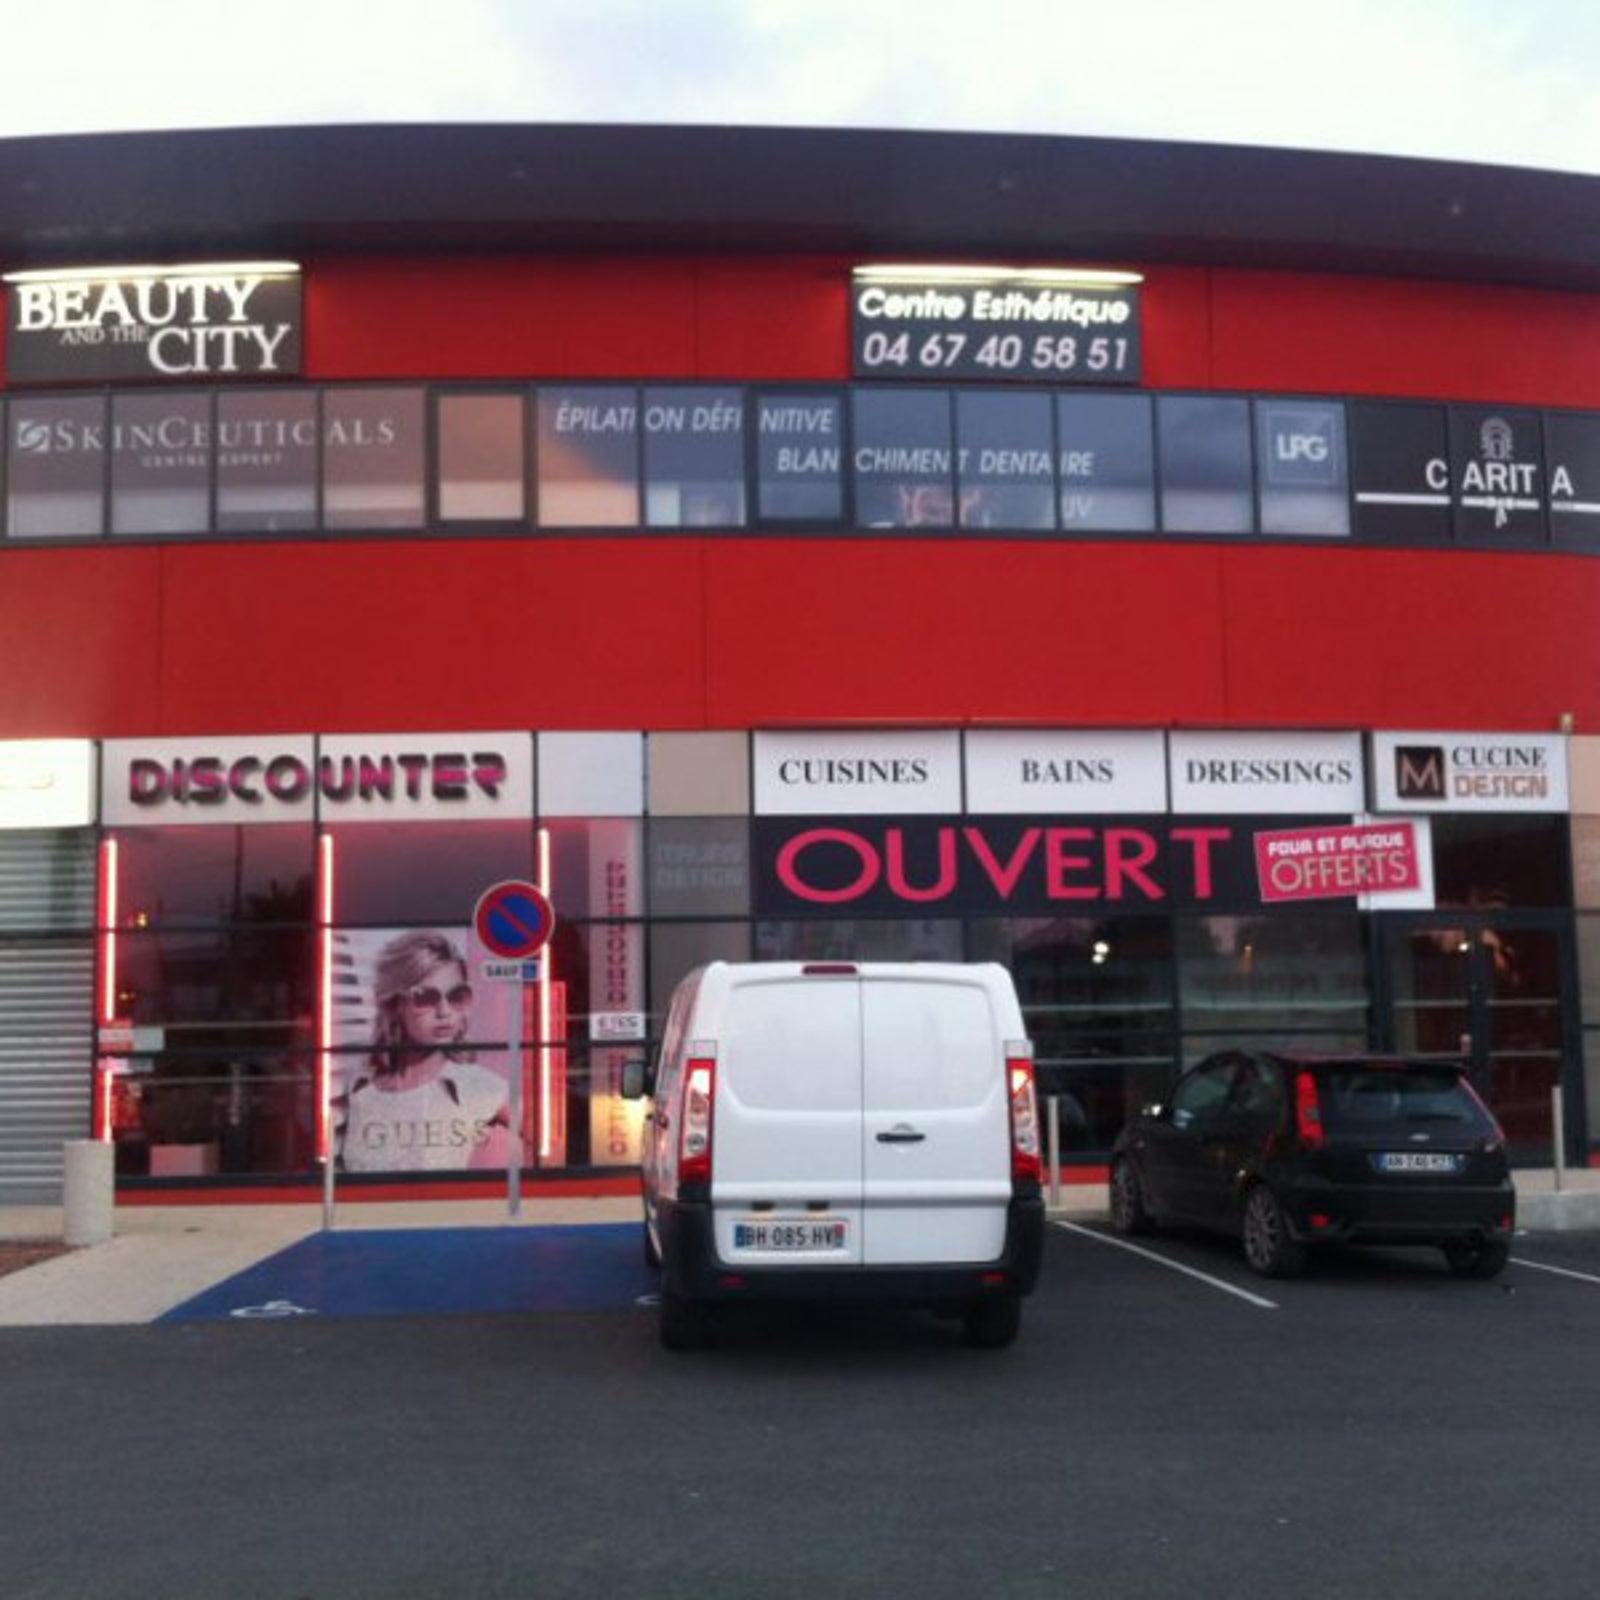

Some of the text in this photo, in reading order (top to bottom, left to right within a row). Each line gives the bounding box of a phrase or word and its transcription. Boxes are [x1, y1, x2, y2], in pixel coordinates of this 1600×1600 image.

[15, 276, 264, 331] BEAUTY
[858, 288, 1130, 328] Centre Esthétique
[60, 326, 148, 345] AND THE
[148, 324, 291, 374] CITY
[863, 332, 1128, 371] 04 67 40 58 51
[1276, 433, 1328, 462] LPG
[778, 758, 929, 785] CUISINES
[1021, 758, 1115, 784] BAINS
[1186, 758, 1353, 785] DRESSINGS
[1452, 746, 1548, 768] CUCINE
[129, 751, 508, 805] DISCOUNTER
[1454, 774, 1548, 798] DESIGN
[1268, 838, 1313, 857] FOUR
[1316, 836, 1337, 852] ET
[775, 825, 1231, 904] OUVERT
[1271, 850, 1408, 892] OFFERTS
[362, 1118, 492, 1151] GUESS
